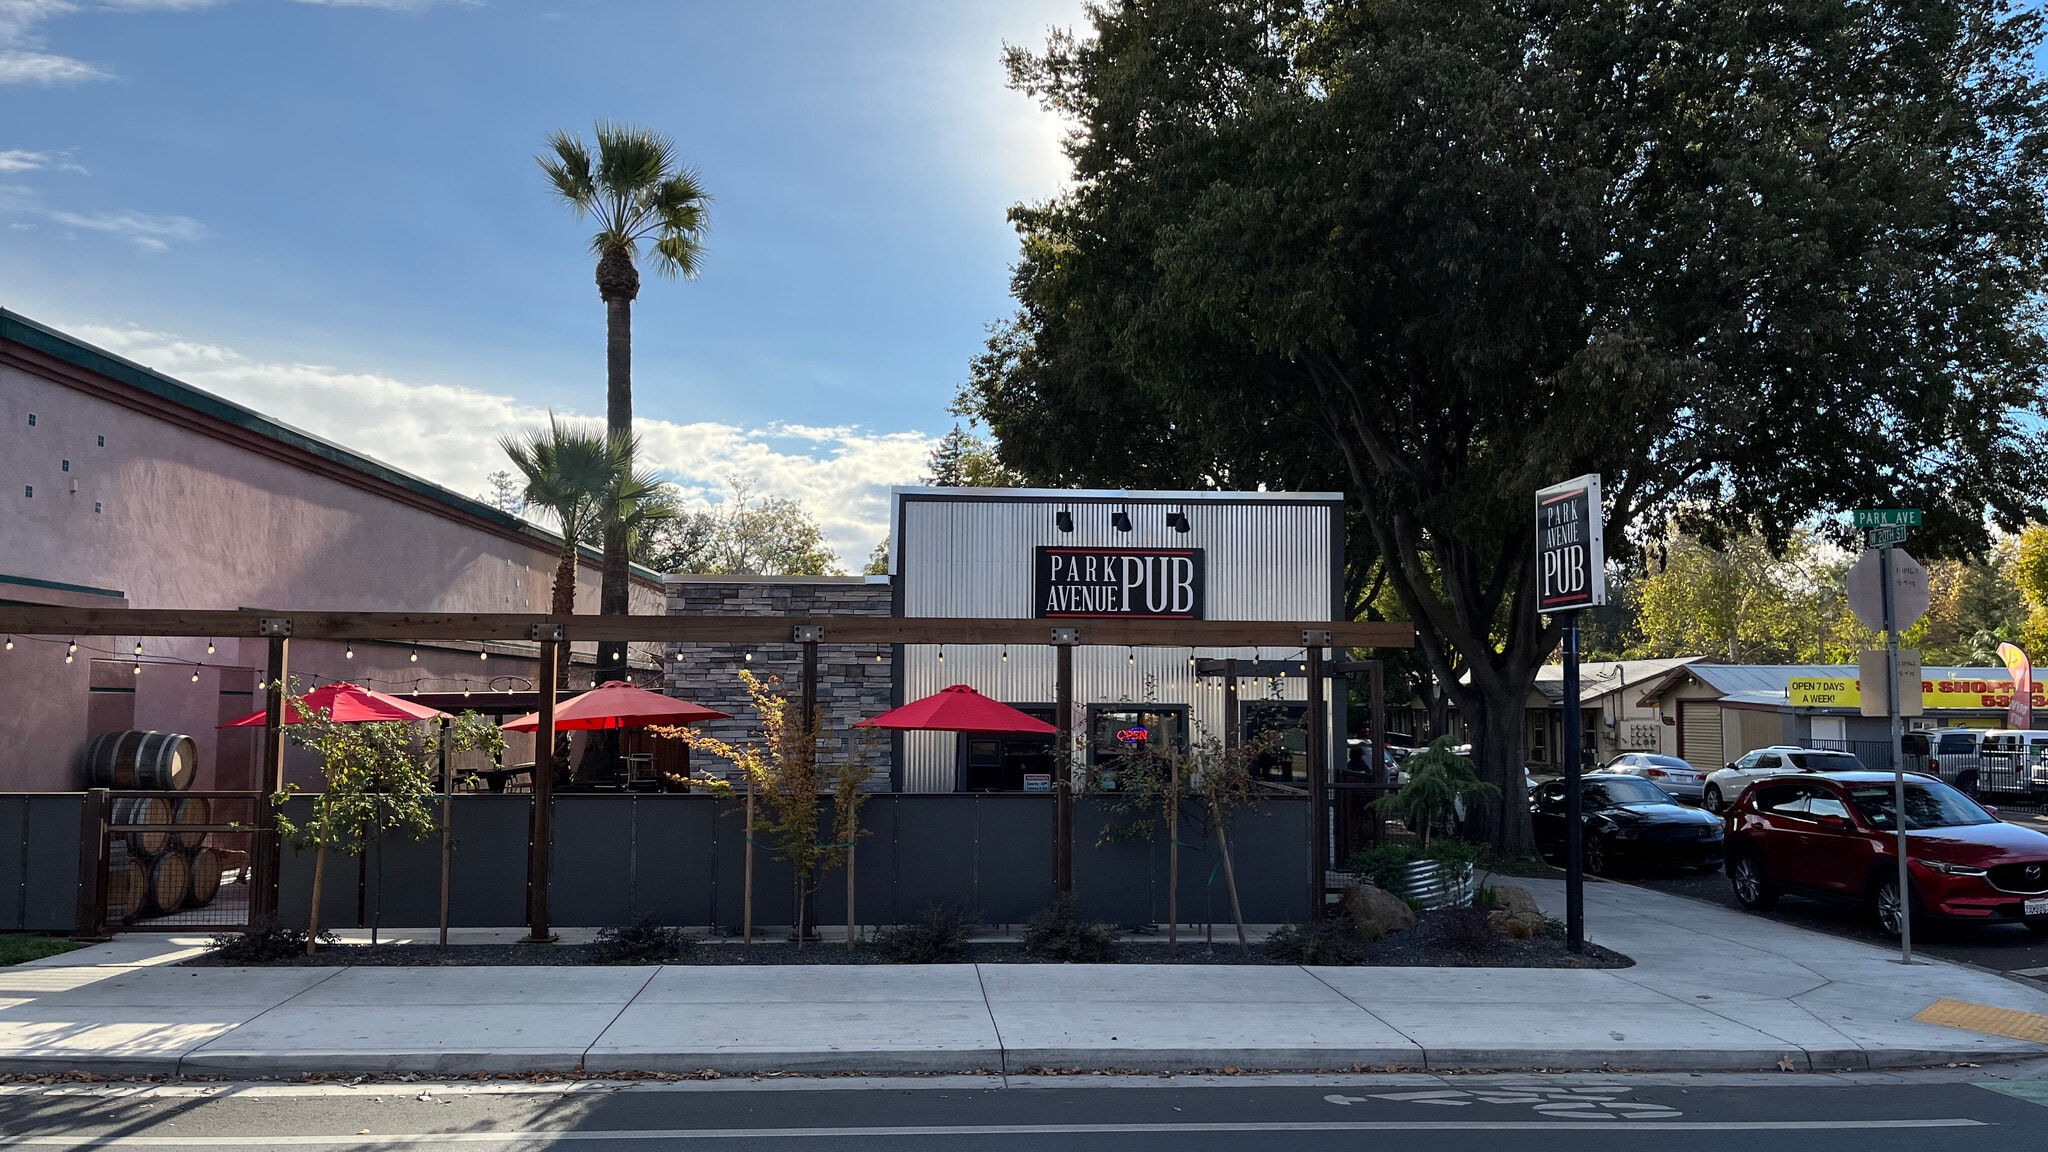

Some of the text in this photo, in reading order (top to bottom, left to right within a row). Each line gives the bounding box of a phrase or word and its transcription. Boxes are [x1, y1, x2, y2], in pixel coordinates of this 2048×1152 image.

[1547, 499, 1578, 527] PARK
[1859, 511, 1916, 524] PARK AVE
[1546, 521, 1579, 549] AVENUE
[1896, 526, 1905, 540] ST
[1050, 555, 1117, 582] PARK
[1543, 544, 1585, 597] PUB
[1120, 556, 1194, 613] PUB
[1045, 585, 1118, 612] AVENUE
[1792, 682, 1815, 691] OPEN
[1816, 682, 1822, 690] 7
[1823, 682, 1845, 691] DAYS
[1938, 681, 2043, 693] SHOPPR
[1802, 694, 1835, 703] A WEEK!
[1116, 729, 1149, 741] OPEN
